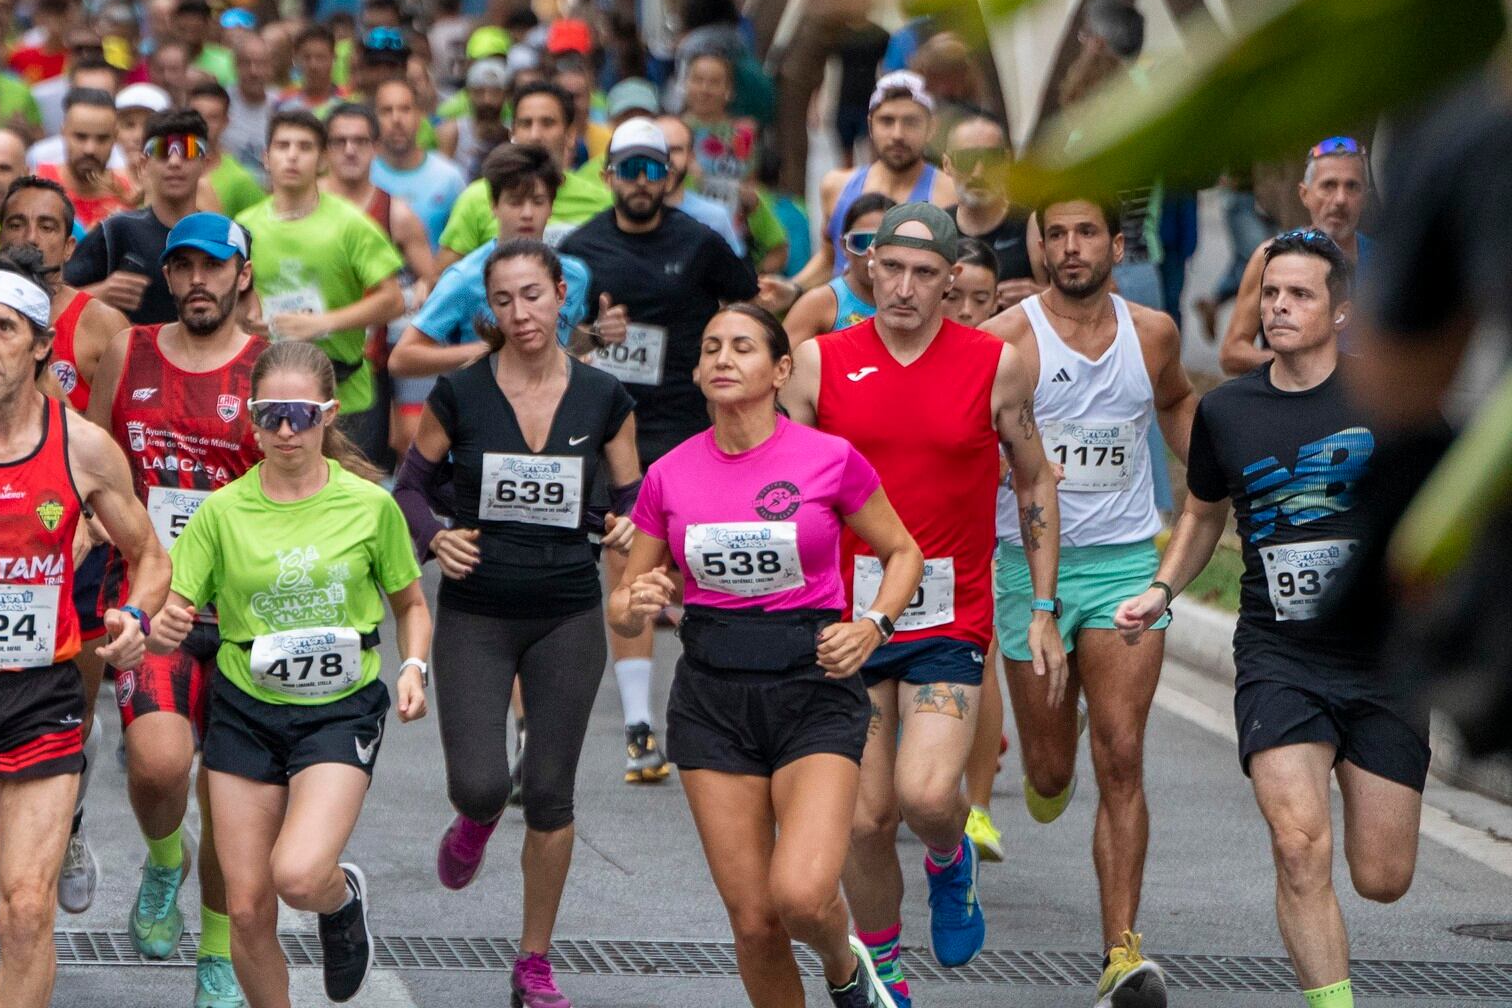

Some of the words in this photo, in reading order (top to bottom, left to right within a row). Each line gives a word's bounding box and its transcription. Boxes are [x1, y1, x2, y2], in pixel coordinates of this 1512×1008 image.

[145, 428, 197, 444] Ayuntamiento
[199, 437, 209, 445] de
[1053, 445, 1125, 466] 1175
[496, 480, 564, 505] 639
[702, 550, 781, 576] 538
[252, 590, 329, 613] Carrera
[266, 653, 343, 681] 478
